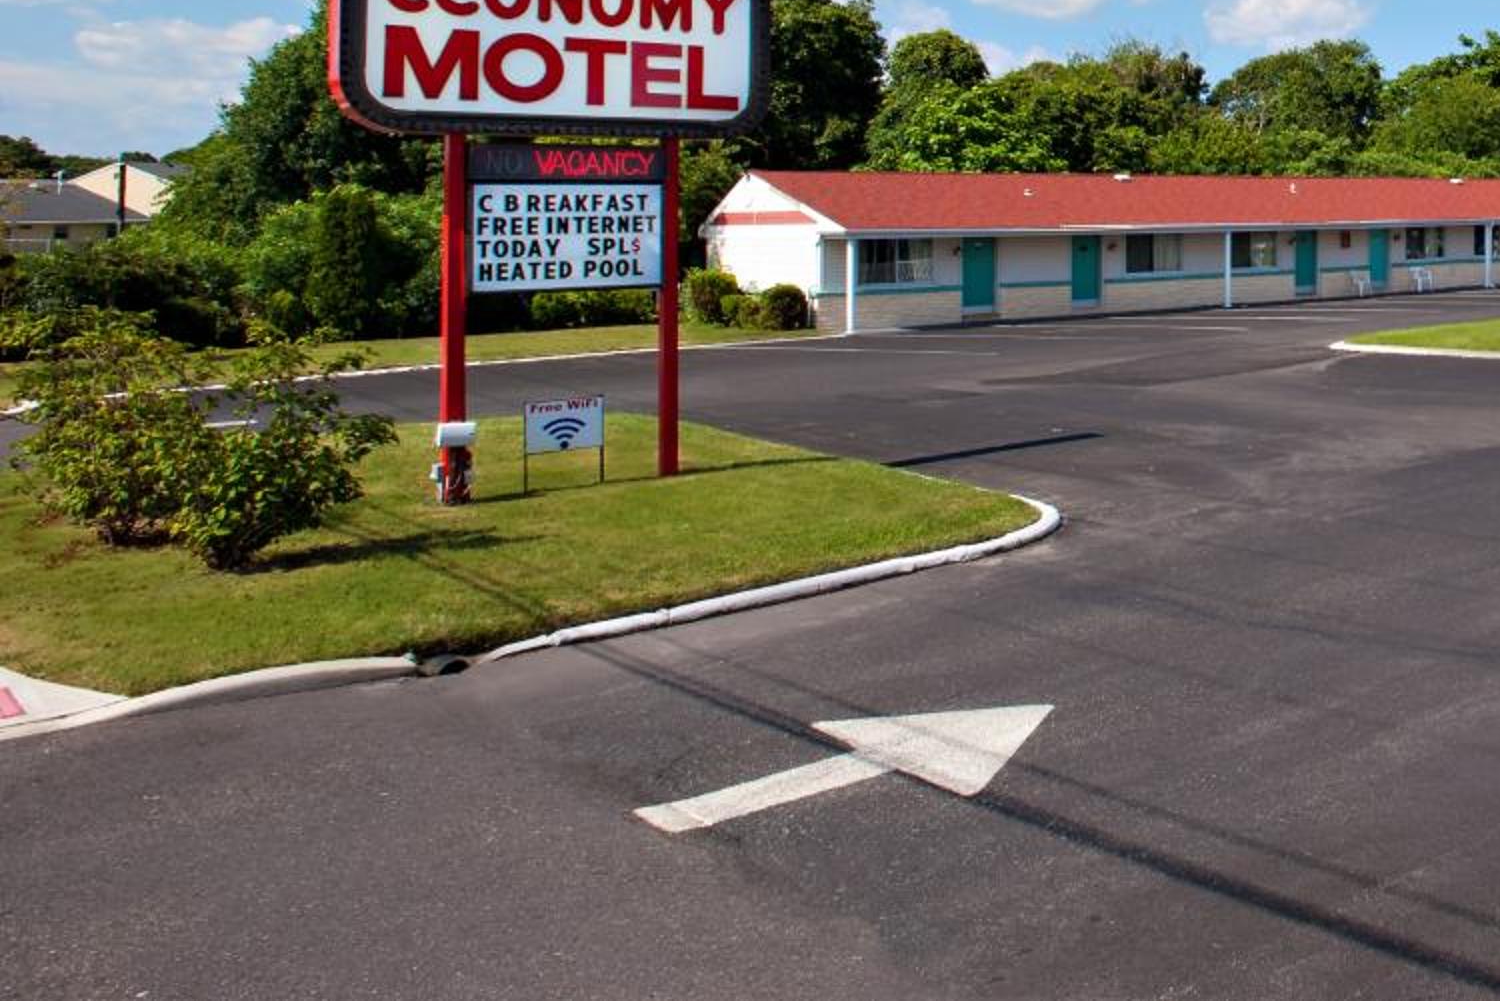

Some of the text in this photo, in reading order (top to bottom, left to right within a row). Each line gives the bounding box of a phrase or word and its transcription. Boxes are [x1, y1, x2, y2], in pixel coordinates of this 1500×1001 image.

[382, 25, 739, 111] MOTEL
[484, 150, 655, 176] NO VACANCY
[479, 194, 493, 213] C
[477, 215, 657, 235] FREE INTERNET
[477, 239, 560, 259] TODAY
[479, 259, 644, 282] HEATED POOL
[530, 403, 563, 414] Free
